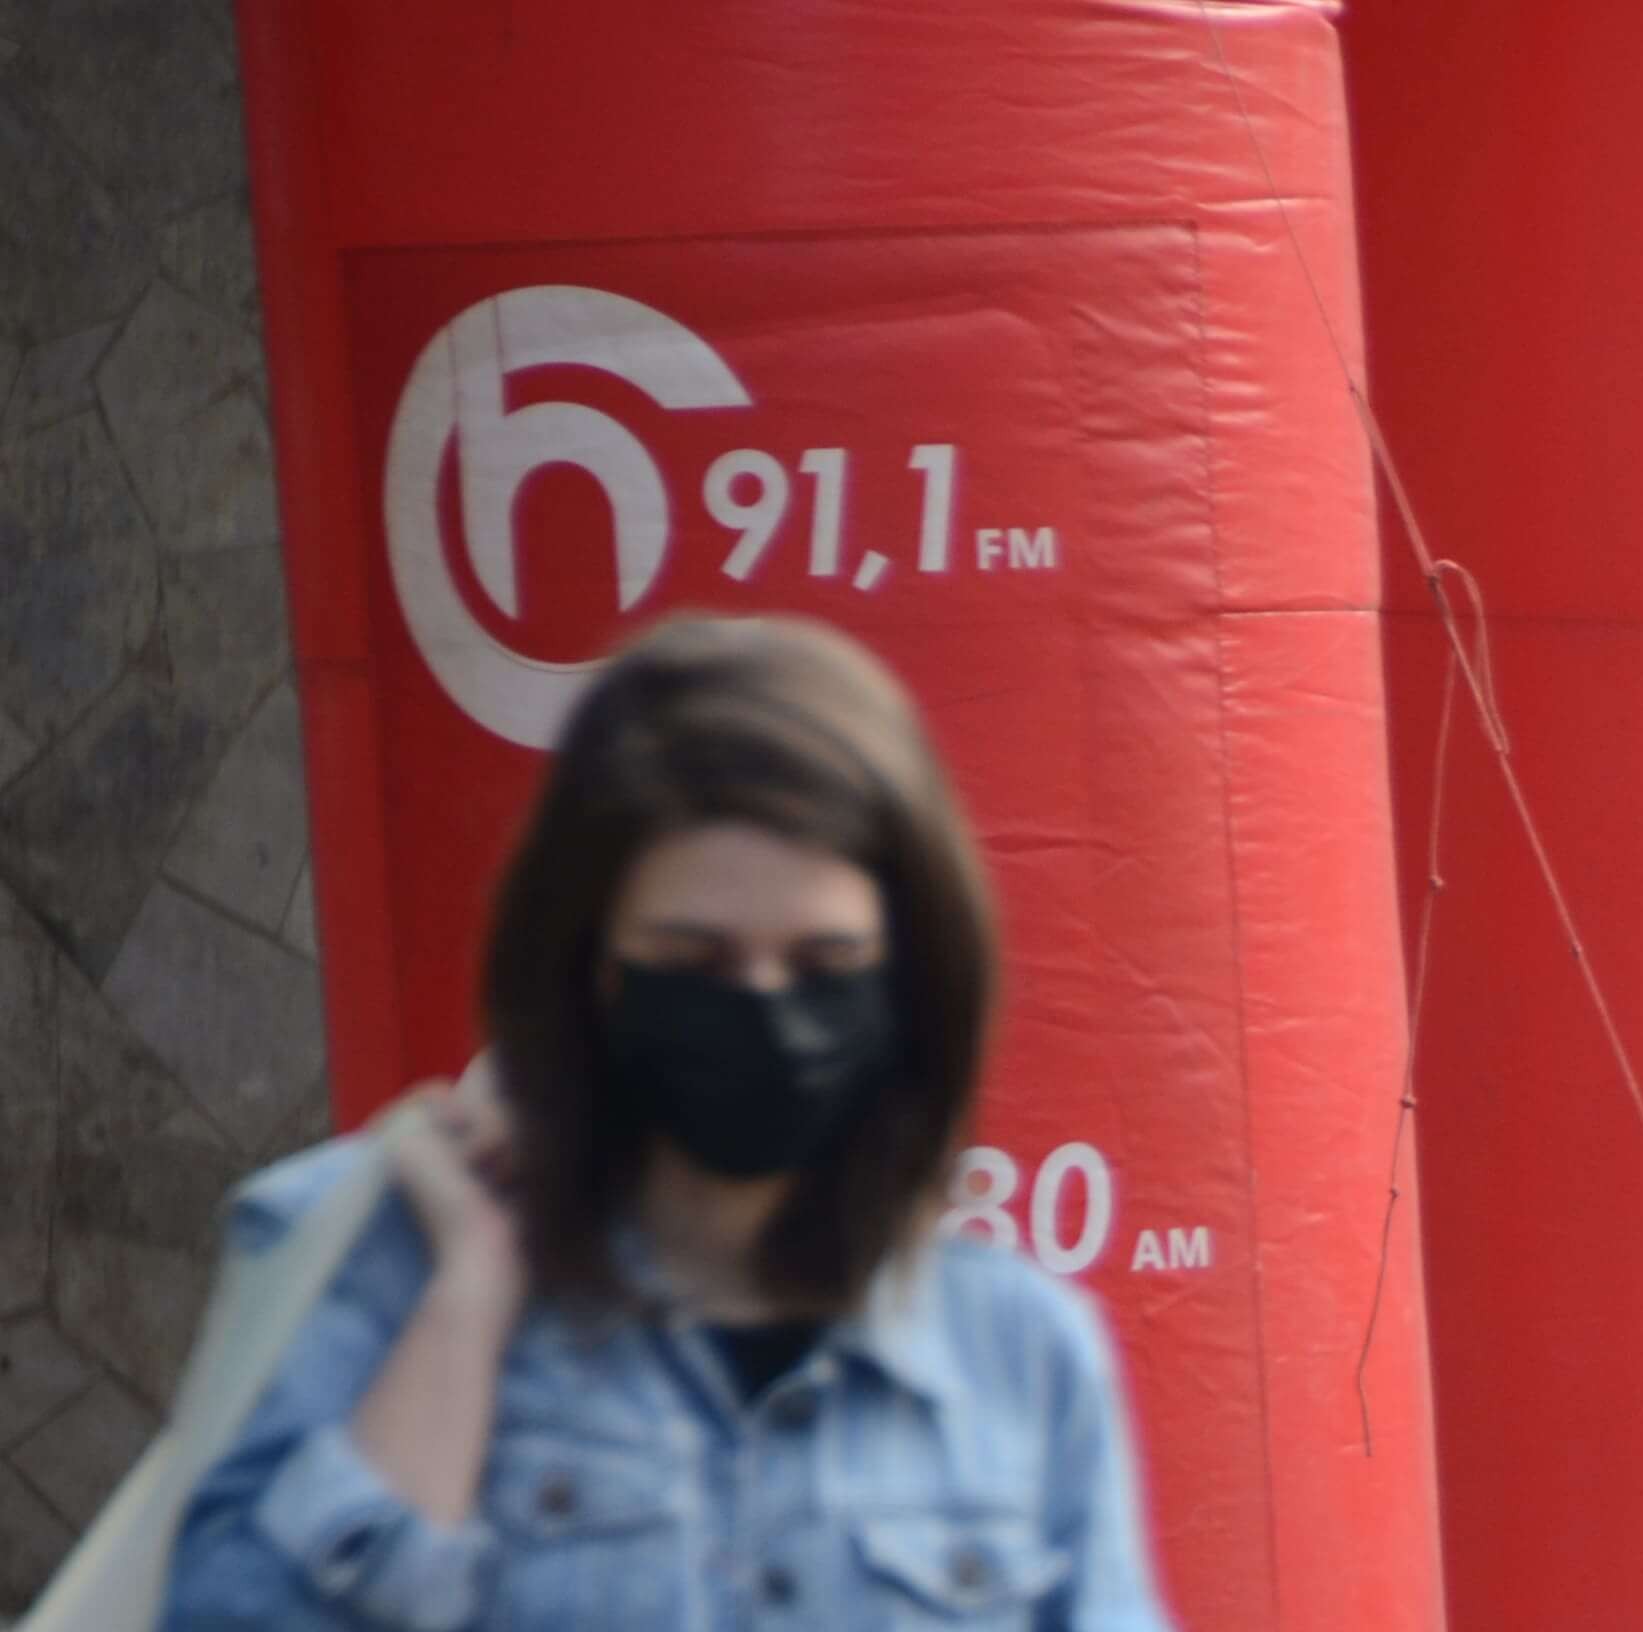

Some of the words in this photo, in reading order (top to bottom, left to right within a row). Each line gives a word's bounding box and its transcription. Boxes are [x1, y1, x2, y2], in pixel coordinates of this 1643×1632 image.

[701, 443, 956, 591] 91,1
[976, 526, 1059, 571] FM
[1131, 1226, 1211, 1273] AM
